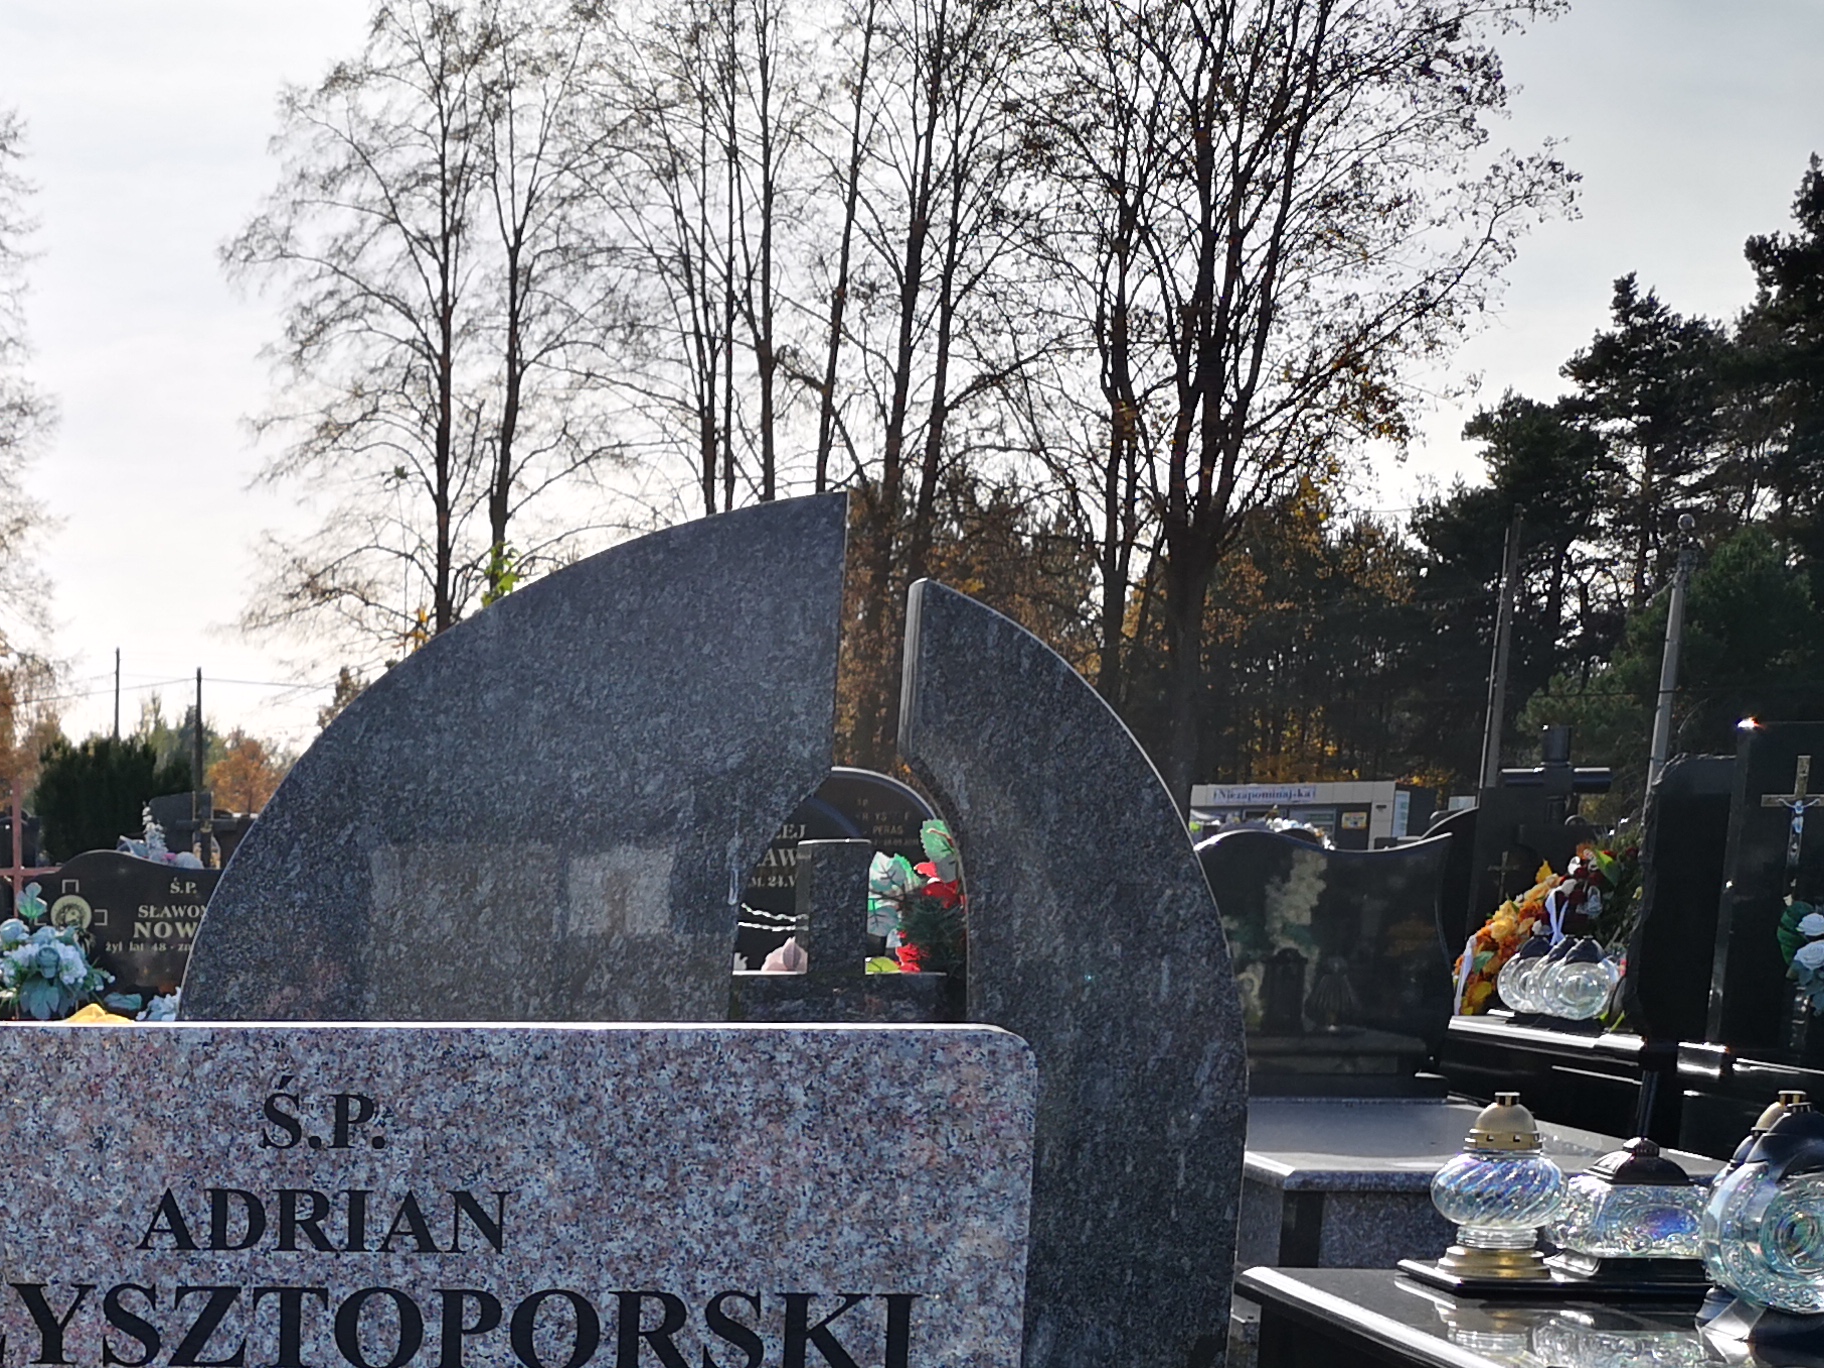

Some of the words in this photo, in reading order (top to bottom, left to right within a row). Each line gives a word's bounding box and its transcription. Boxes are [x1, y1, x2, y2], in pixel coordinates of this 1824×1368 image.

[170, 876, 197, 894] Ś.P.
[260, 1075, 386, 1150] Ś.P.
[134, 1186, 512, 1255] ADRIAN
